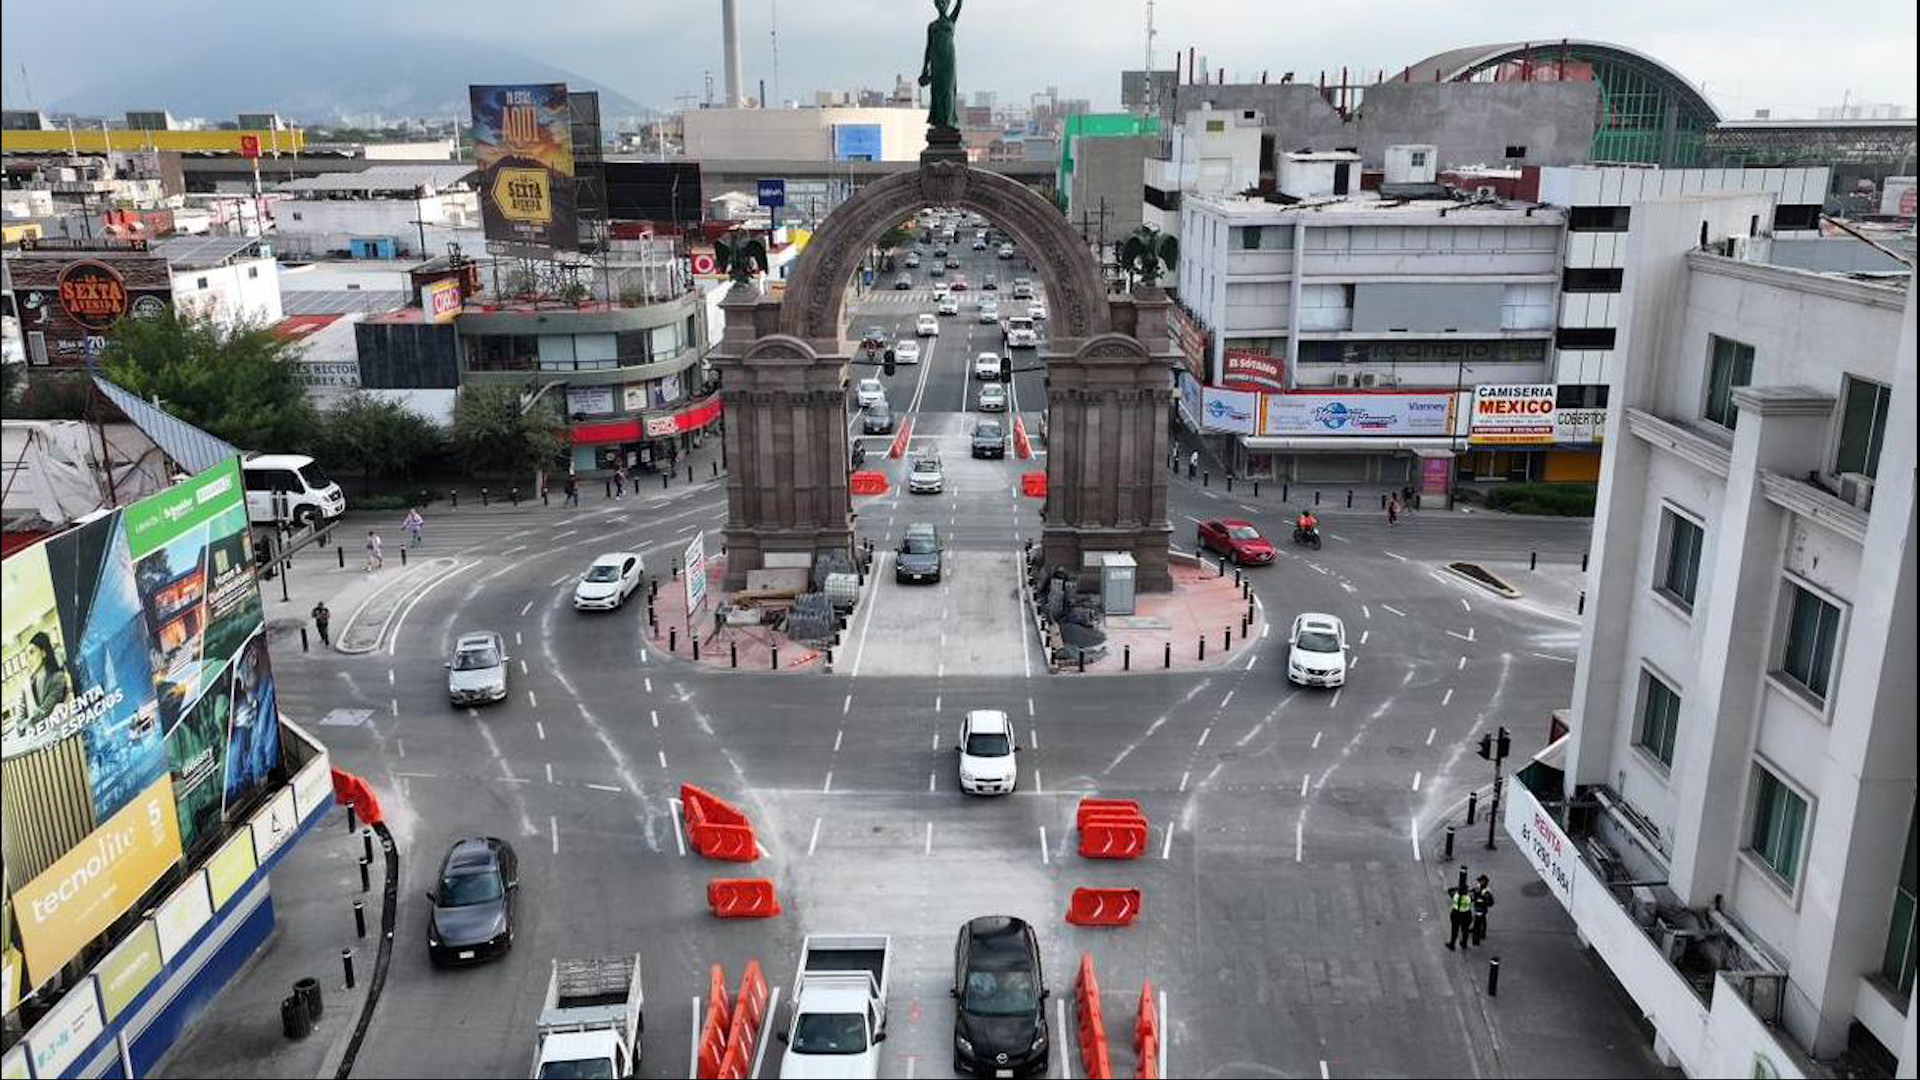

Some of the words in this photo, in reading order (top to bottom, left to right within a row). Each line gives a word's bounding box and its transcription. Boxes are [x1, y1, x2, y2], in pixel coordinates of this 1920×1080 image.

[508, 181, 543, 200] SEXTA
[63, 281, 123, 300] SEXTA
[70, 299, 122, 313] AVENIDA
[1479, 387, 1554, 397] CAMISERIA
[1480, 400, 1553, 414] MEXICO
[24, 684, 105, 739] REINVENTA
[61, 688, 124, 739] ESPACIOS
[1534, 811, 1564, 857] RENTA
[31, 826, 136, 924] tecnolite
